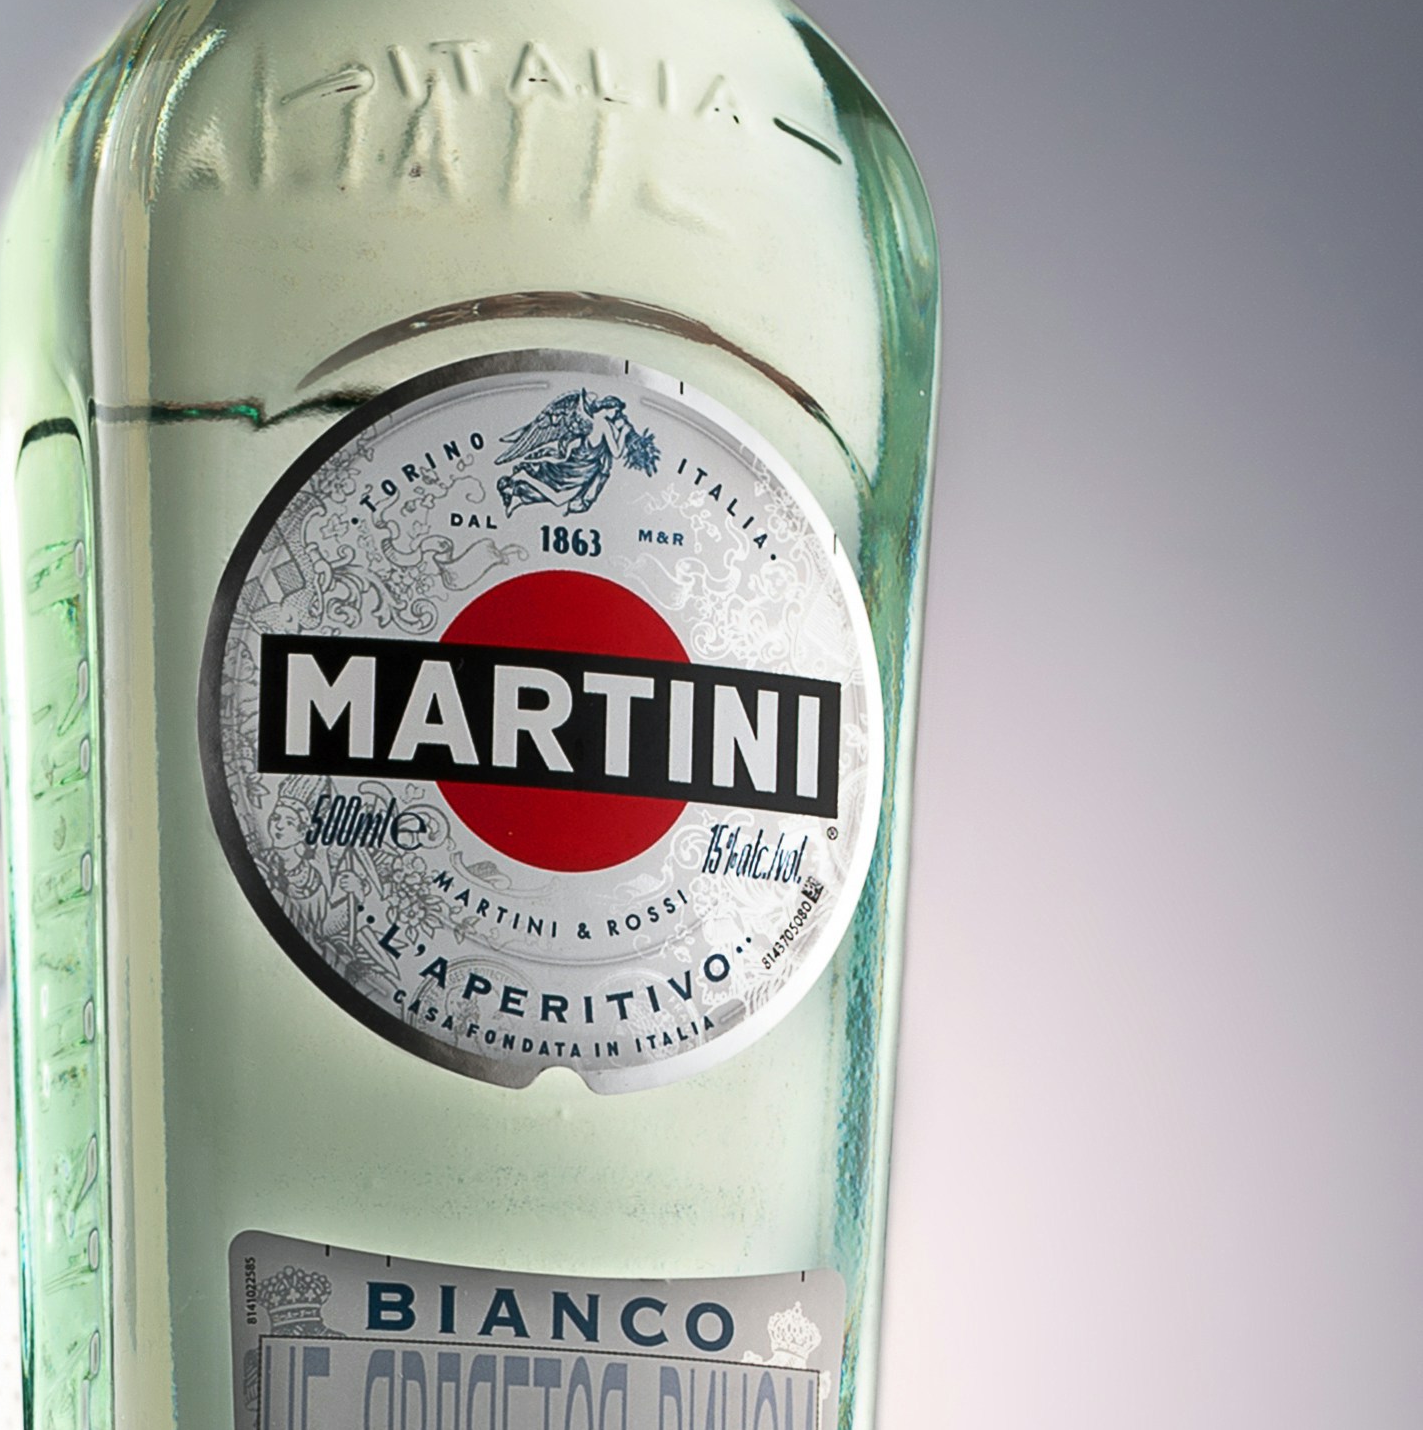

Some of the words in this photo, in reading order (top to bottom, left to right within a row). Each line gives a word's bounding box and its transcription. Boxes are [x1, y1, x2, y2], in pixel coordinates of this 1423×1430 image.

[387, 40, 743, 125] ITALIA
[360, 432, 484, 512] TORINO
[677, 458, 767, 549] ITALIA
[450, 513, 497, 529] DAL
[540, 525, 602, 557] 1863
[285, 653, 820, 799] MARTINI
[433, 871, 557, 939] MARTINI
[577, 923, 592, 940] &
[607, 889, 689, 936] ROSSI
[762, 900, 812, 969] 8143705080
[379, 922, 731, 1023] L'APERITIVO
[392, 988, 455, 1030] CASA
[467, 1024, 580, 1058] FONDATA
[595, 1042, 620, 1058] IN
[636, 1016, 715, 1054] ITALIA
[365, 1280, 735, 1353] BIANCO
